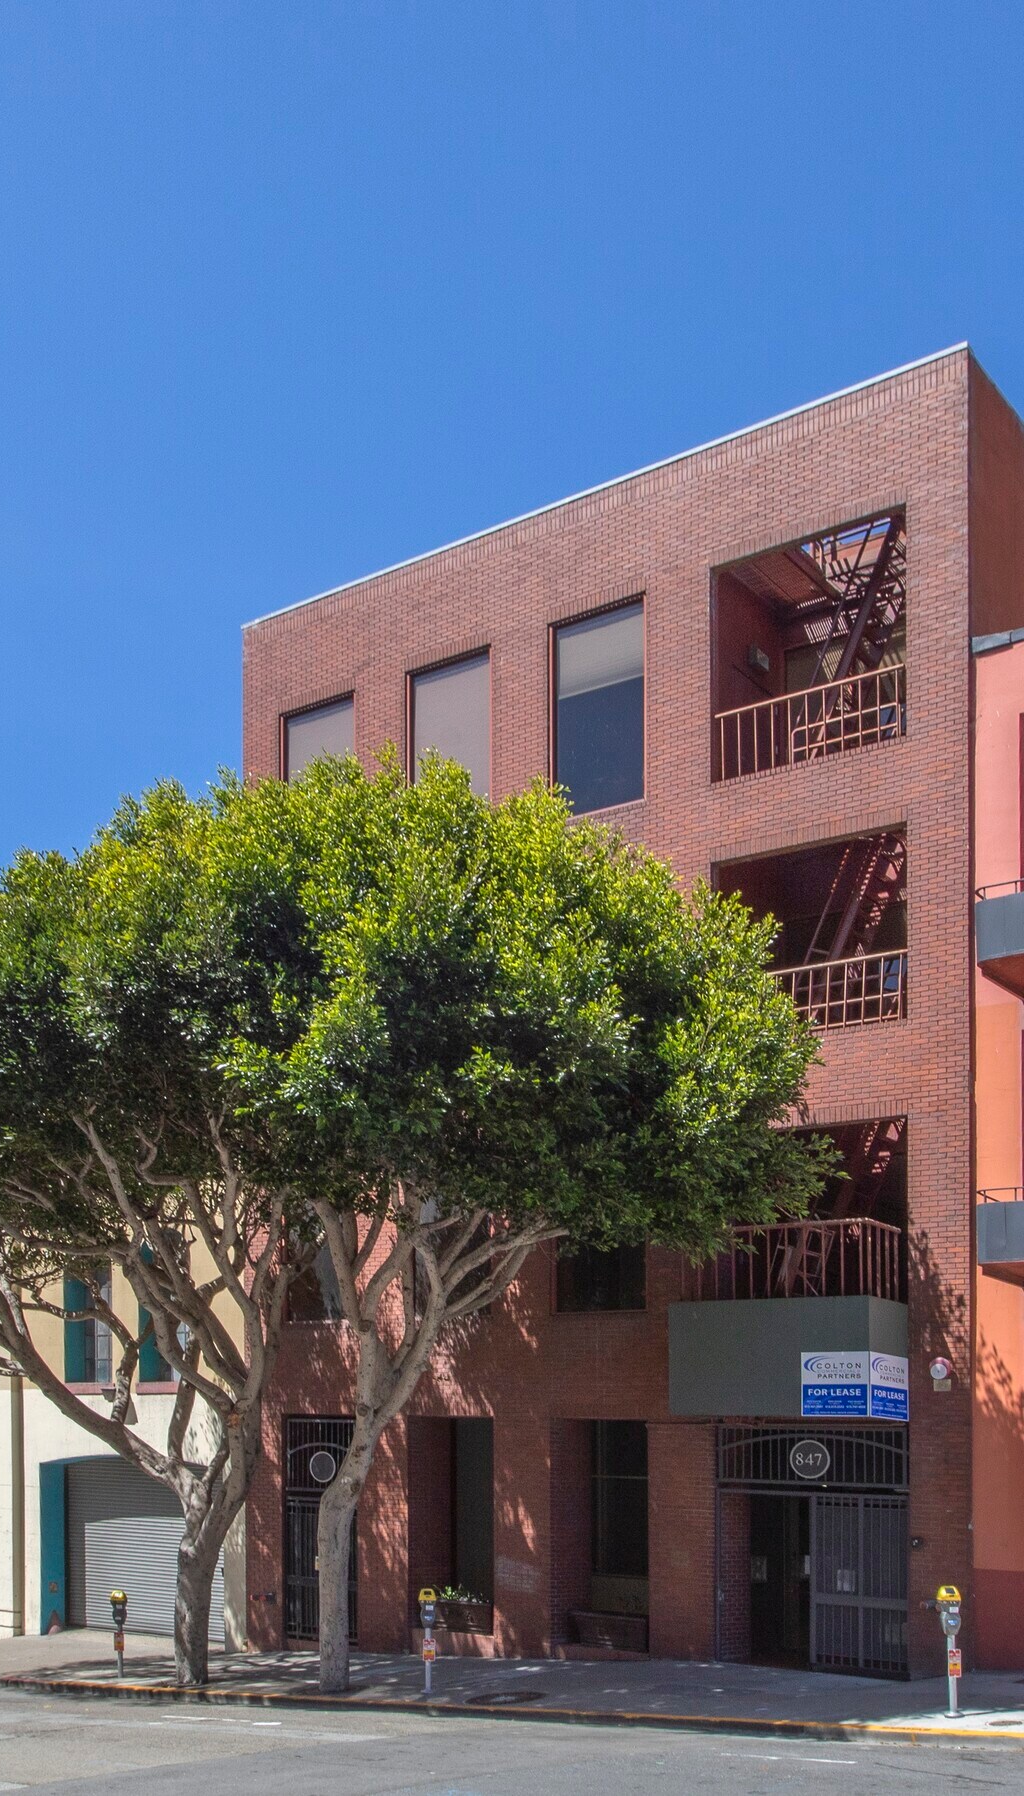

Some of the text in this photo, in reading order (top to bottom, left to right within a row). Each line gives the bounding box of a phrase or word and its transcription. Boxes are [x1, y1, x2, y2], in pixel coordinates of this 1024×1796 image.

[879, 1364, 905, 1375] COLTON
[879, 1375, 905, 1385] PARTNERS
[808, 1388, 862, 1396] FOR LEASE
[874, 1389, 905, 1401] FOR LEASE
[796, 1452, 822, 1466] 847
